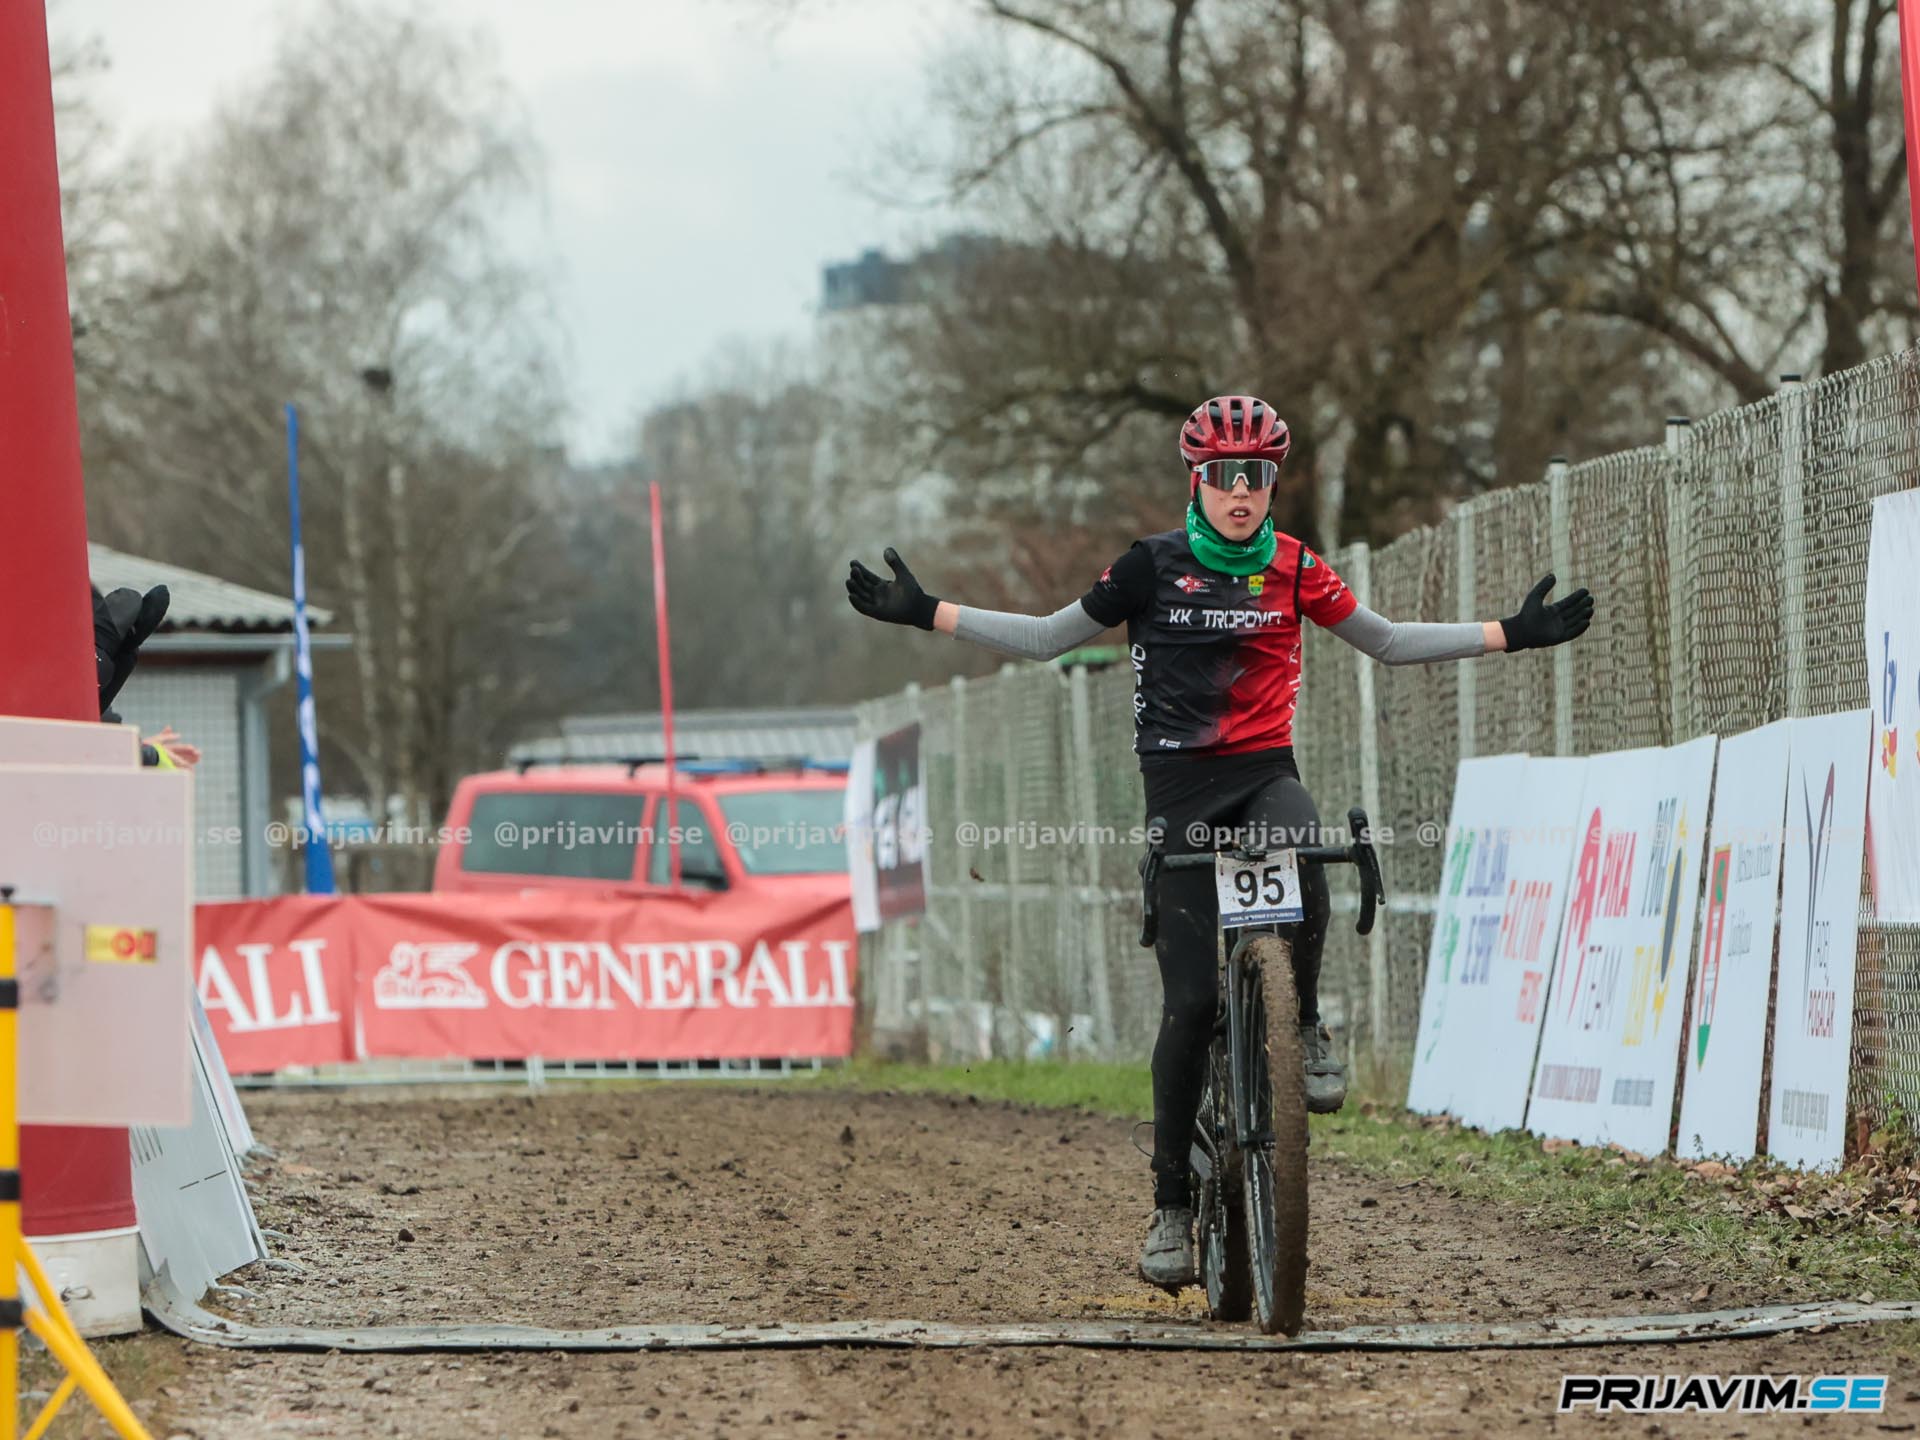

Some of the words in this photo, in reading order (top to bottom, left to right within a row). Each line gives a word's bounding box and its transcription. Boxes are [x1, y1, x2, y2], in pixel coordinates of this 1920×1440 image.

[1169, 608, 1193, 626] KK
[1233, 864, 1286, 908] 95
[490, 940, 853, 1010] GENERALI
